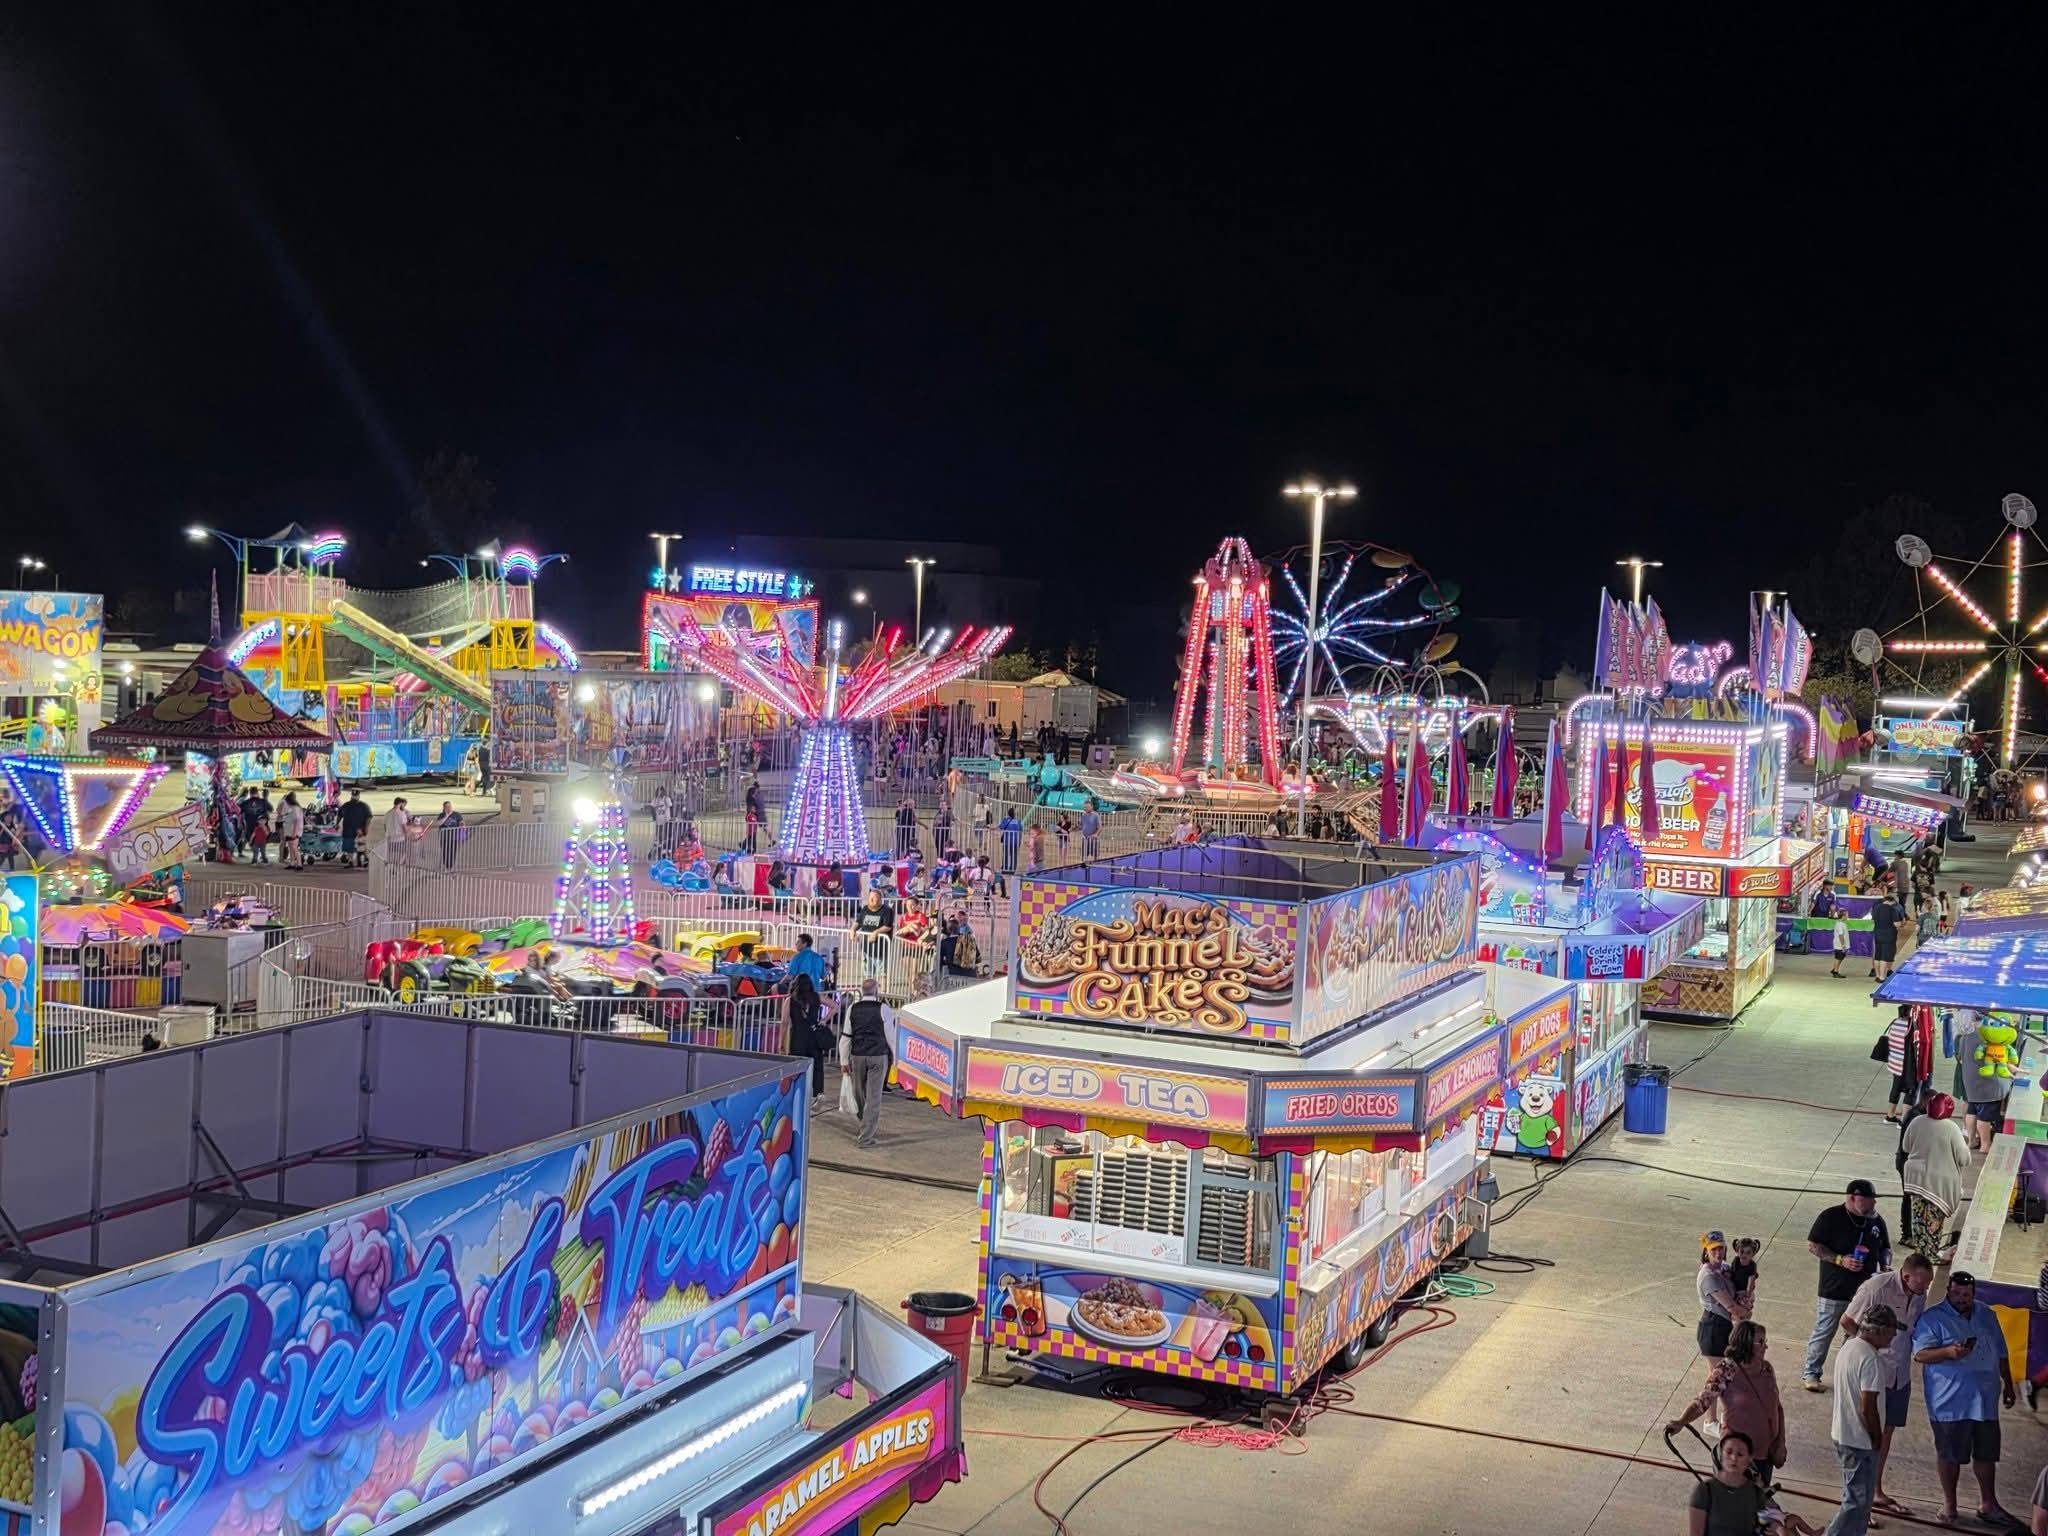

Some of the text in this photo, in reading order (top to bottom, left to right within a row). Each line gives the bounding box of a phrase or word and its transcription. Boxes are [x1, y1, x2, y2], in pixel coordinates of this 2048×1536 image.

[692, 566, 785, 595] FREE STYLE
[0, 621, 100, 658] WAGON
[1662, 817, 1700, 832] BEER
[1656, 868, 1715, 891] BEER
[1594, 957, 1619, 965] Drink
[1601, 965, 1623, 975] Town
[1520, 1011, 1561, 1055] HOT DOGS
[906, 1038, 949, 1077] FRIED OREOS
[1002, 1062, 1211, 1119] ICED TEA
[1428, 1048, 1497, 1117] PINK LEMONADE
[1287, 1093, 1398, 1121] FRIED OREOS
[137, 1120, 773, 1536] Sweets & Treats
[747, 1415, 930, 1536] ARAMEL APPLES
